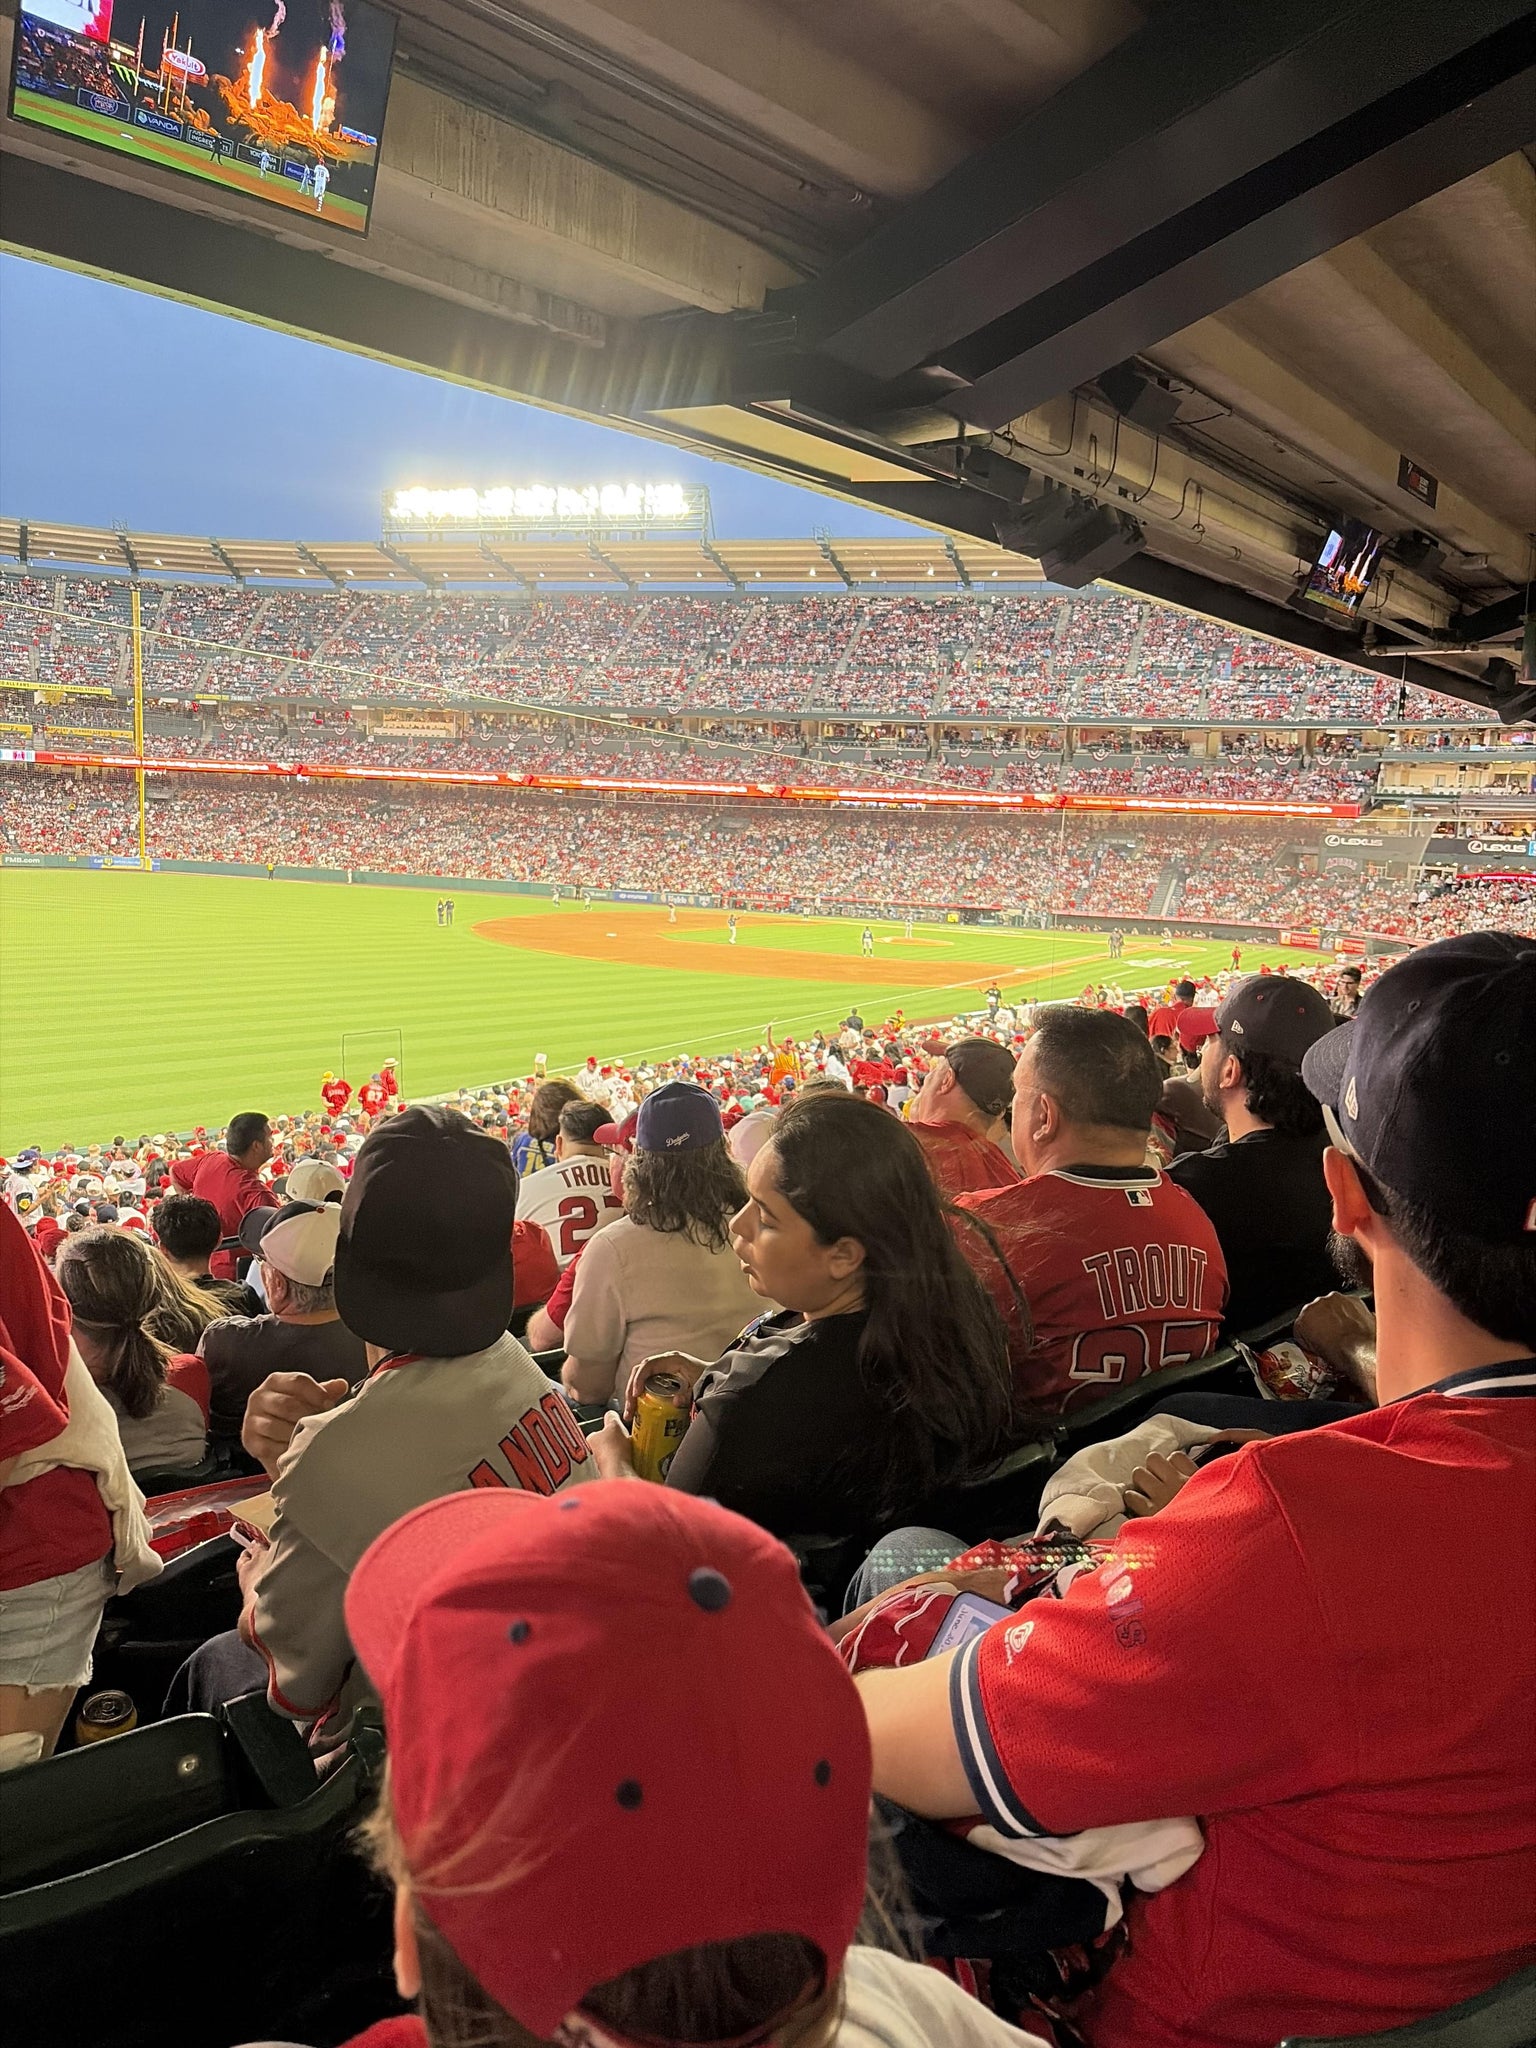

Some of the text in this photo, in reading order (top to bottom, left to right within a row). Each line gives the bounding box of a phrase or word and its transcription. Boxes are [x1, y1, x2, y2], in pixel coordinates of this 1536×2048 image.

[147, 116, 180, 132] VANDA
[1341, 838, 1383, 846] LEXUS
[1483, 844, 1526, 853] LEXUS
[665, 1132, 690, 1147] Dodgers
[556, 1163, 612, 1188] TROU
[1082, 1243, 1208, 1320] TROUT
